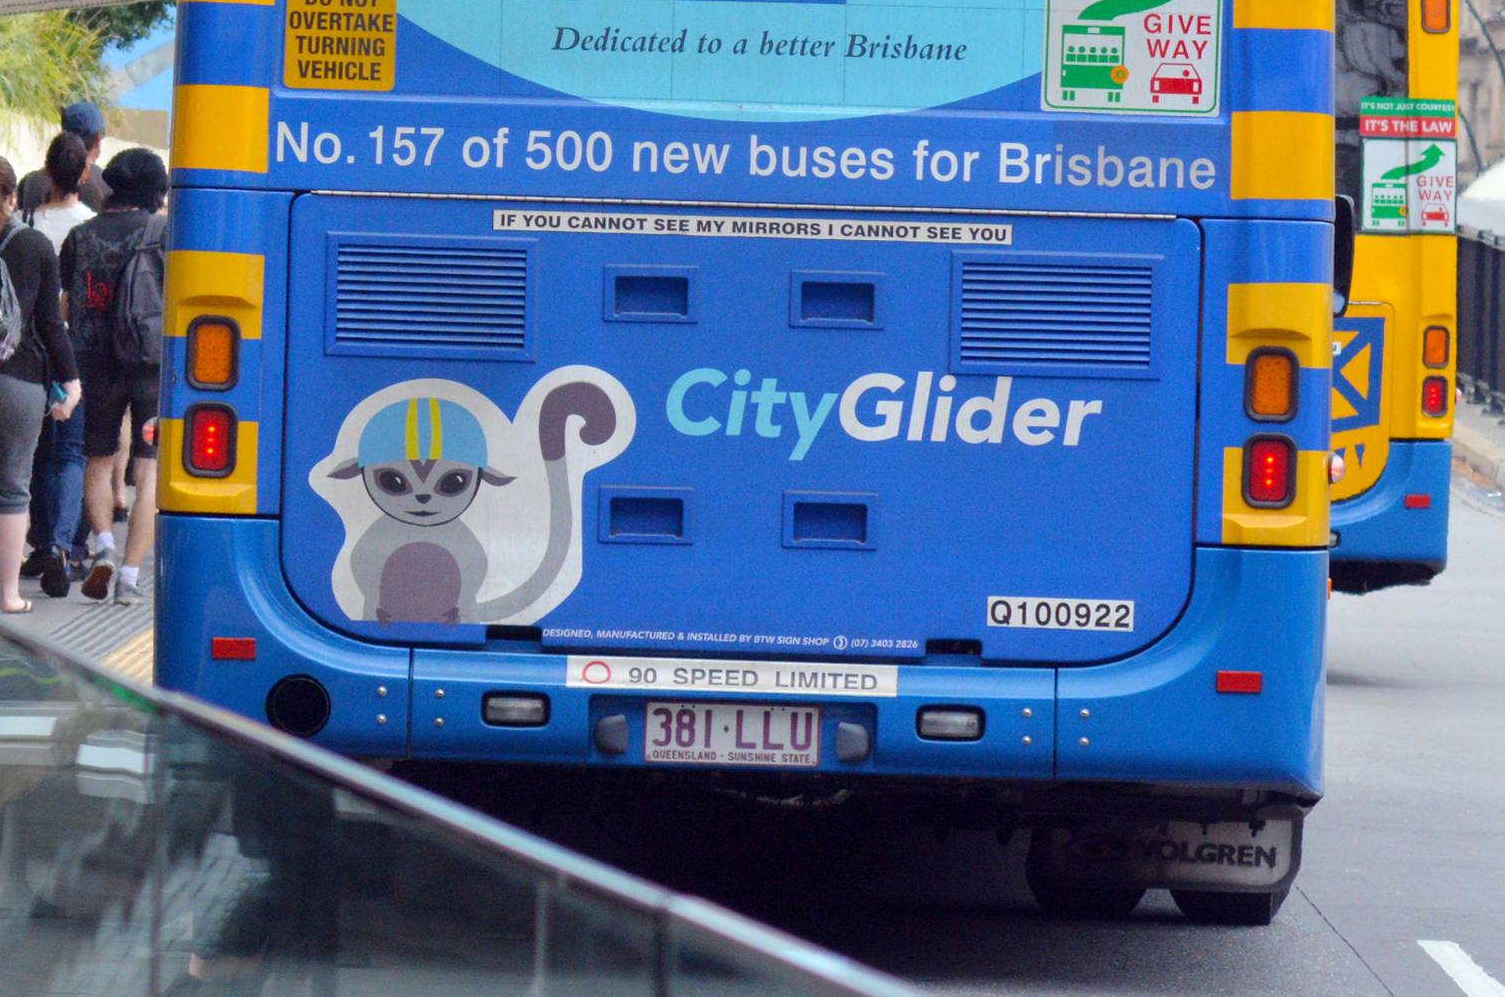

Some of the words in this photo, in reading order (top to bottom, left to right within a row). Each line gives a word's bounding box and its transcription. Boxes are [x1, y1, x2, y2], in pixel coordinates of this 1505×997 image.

[289, 11, 394, 33] OVERTAKE
[1143, 13, 1212, 35] GIVE
[295, 35, 386, 57] TURNING
[551, 26, 688, 54] Dedicated
[697, 32, 722, 55] to
[732, 40, 748, 55] a
[758, 31, 836, 58] better
[845, 33, 968, 61] Brisbane
[1146, 38, 1208, 59] WAY
[297, 60, 382, 81] VEHICLE
[1361, 101, 1375, 110] IT'S
[1377, 102, 1394, 110] NOT
[1396, 102, 1414, 111] JUST
[1416, 103, 1455, 112] COURTESY
[1365, 119, 1389, 132] IT'S
[1392, 120, 1419, 133] THE
[1422, 121, 1453, 133] LAW
[276, 121, 354, 164] No.
[368, 125, 445, 166] 157
[462, 126, 509, 169] of
[525, 129, 613, 172] 500
[632, 139, 731, 175] new
[749, 134, 895, 179] buses
[912, 139, 980, 182] for
[998, 142, 1216, 190] Brisbane
[1416, 175, 1454, 188] GIVE
[1418, 190, 1453, 202] WAY
[500, 214, 517, 227] IF
[522, 214, 561, 228] YOU
[567, 215, 648, 231] CANNOT
[653, 218, 690, 232] SEE
[696, 220, 725, 233] MY
[731, 220, 822, 236] MIRRORS
[828, 224, 833, 236] I
[839, 223, 921, 239] CANNOT
[926, 226, 963, 240] SEE
[969, 227, 1007, 242] YOU
[665, 367, 1103, 460] CityGlider
[990, 599, 1132, 629] Q100922
[542, 628, 594, 639] DESIGNED,
[596, 629, 675, 640] MANUFACTURED
[677, 631, 685, 641] &
[686, 632, 737, 642] INSTALLED
[739, 634, 752, 643] BY
[753, 635, 775, 644] BTW
[776, 635, 801, 645] SIGN
[802, 637, 830, 646] SHOP
[850, 638, 869, 648] (07)
[870, 639, 894, 648] 3403
[895, 639, 919, 649] 2826
[628, 666, 658, 684] 90
[673, 667, 759, 687] SPEED
[774, 670, 878, 690] LIMITED
[652, 749, 717, 761] QUEENSLAND
[727, 752, 777, 763] SUNSHINE
[781, 754, 811, 764] STATE
